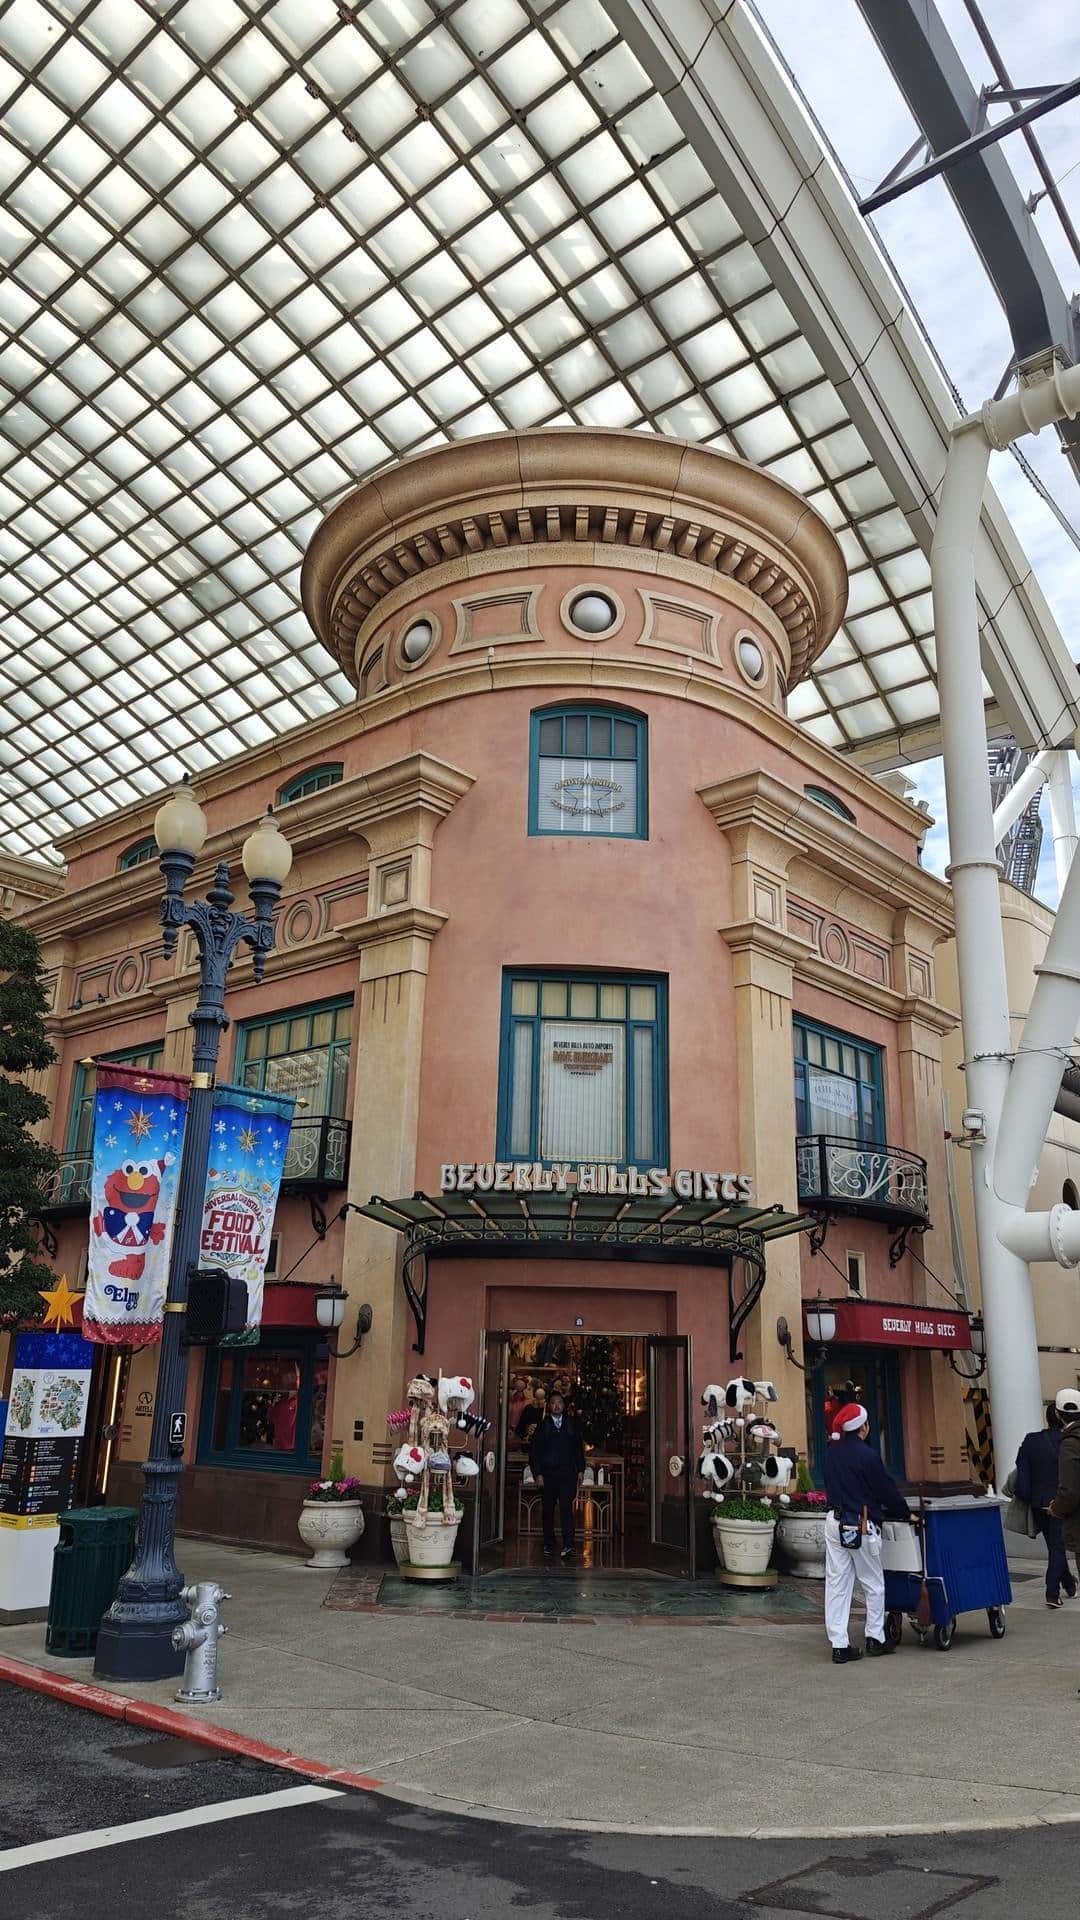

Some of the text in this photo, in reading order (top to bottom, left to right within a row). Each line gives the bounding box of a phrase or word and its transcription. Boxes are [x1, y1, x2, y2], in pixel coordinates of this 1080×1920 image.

[440, 1162, 753, 1201] BEVERLY HILLS GIFTS
[204, 1193, 238, 1214] NIVERSAL
[208, 1210, 255, 1234] FOOD
[201, 1229, 264, 1254] ESTIVAL
[882, 1318, 956, 1336] BEVERLY HILLS GIFTS
